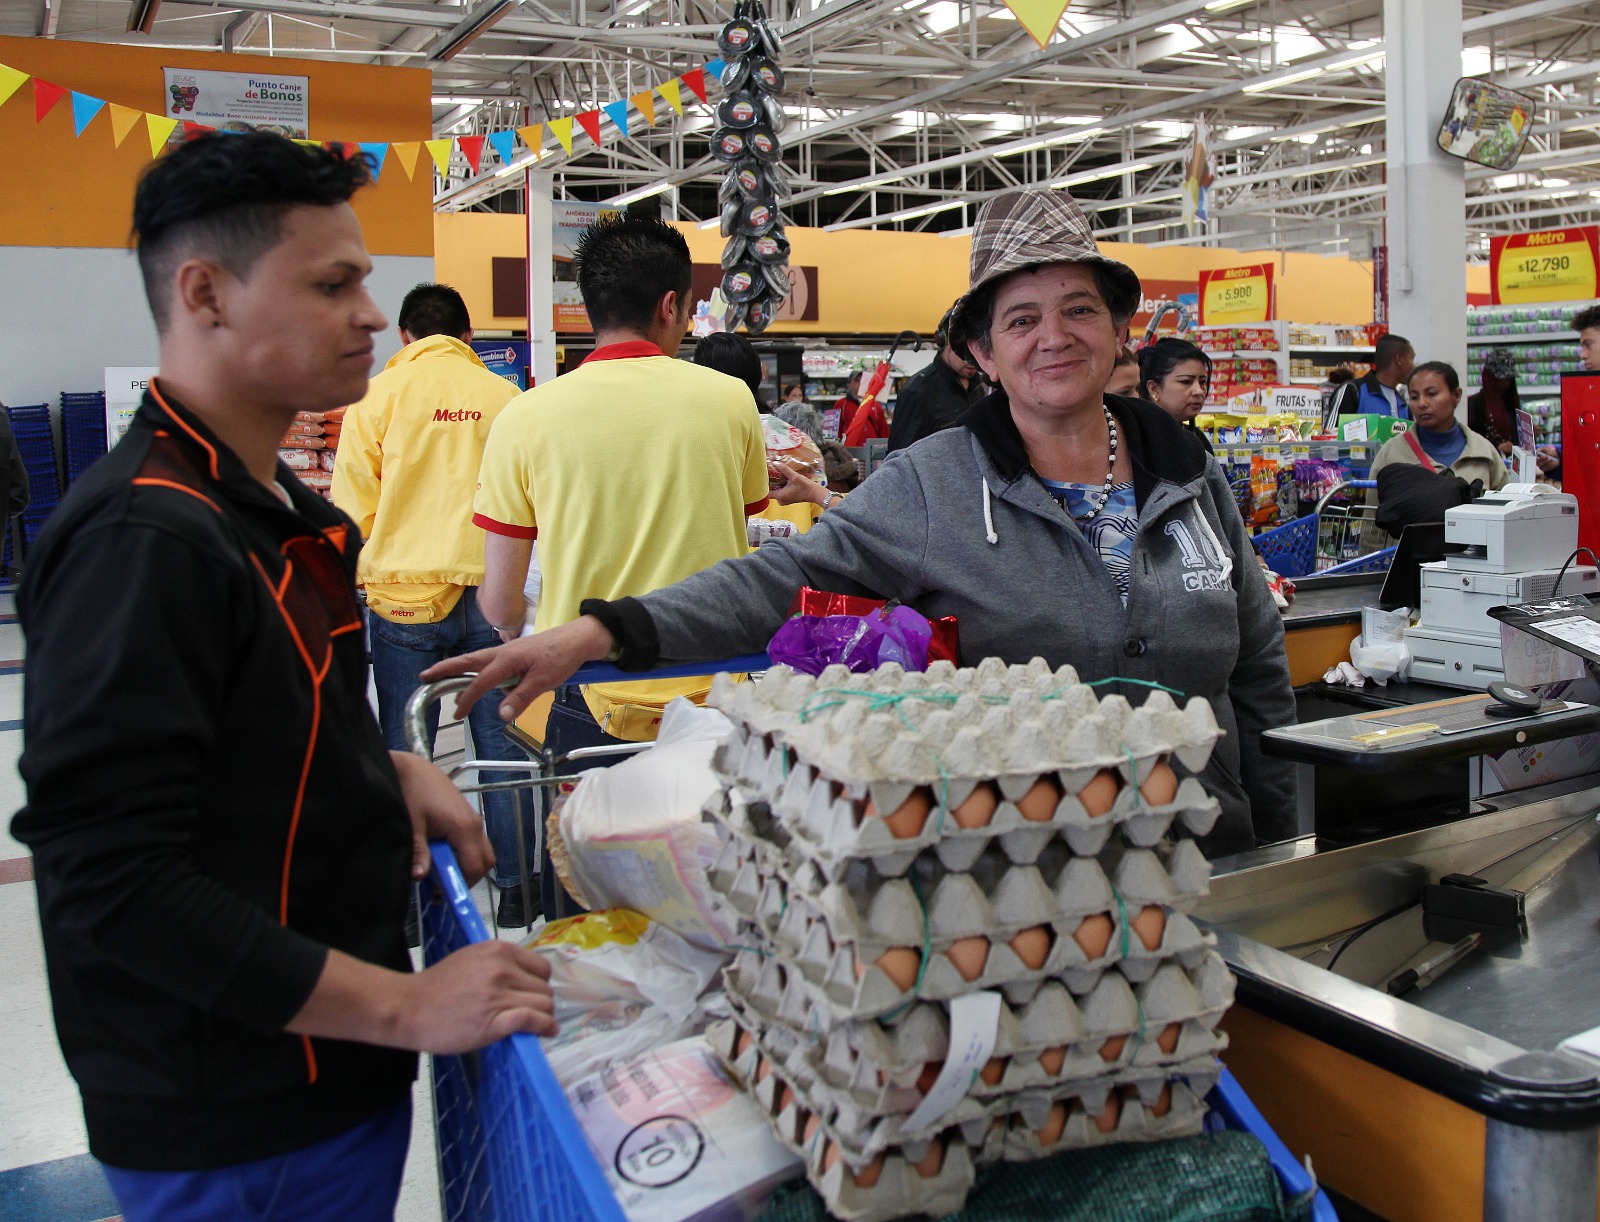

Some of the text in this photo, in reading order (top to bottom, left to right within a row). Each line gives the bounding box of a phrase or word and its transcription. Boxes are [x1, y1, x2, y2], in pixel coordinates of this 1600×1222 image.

[249, 80, 302, 92] Punto Canje
[245, 89, 302, 102] de Bonos
[1526, 231, 1565, 246] Metro
[1518, 256, 1570, 273] $12.790
[1224, 268, 1251, 279] Metro
[1225, 285, 1252, 300] 5.900
[1275, 395, 1306, 407] FRUTAS
[432, 408, 482, 422] Metro
[389, 609, 415, 618] Metro
